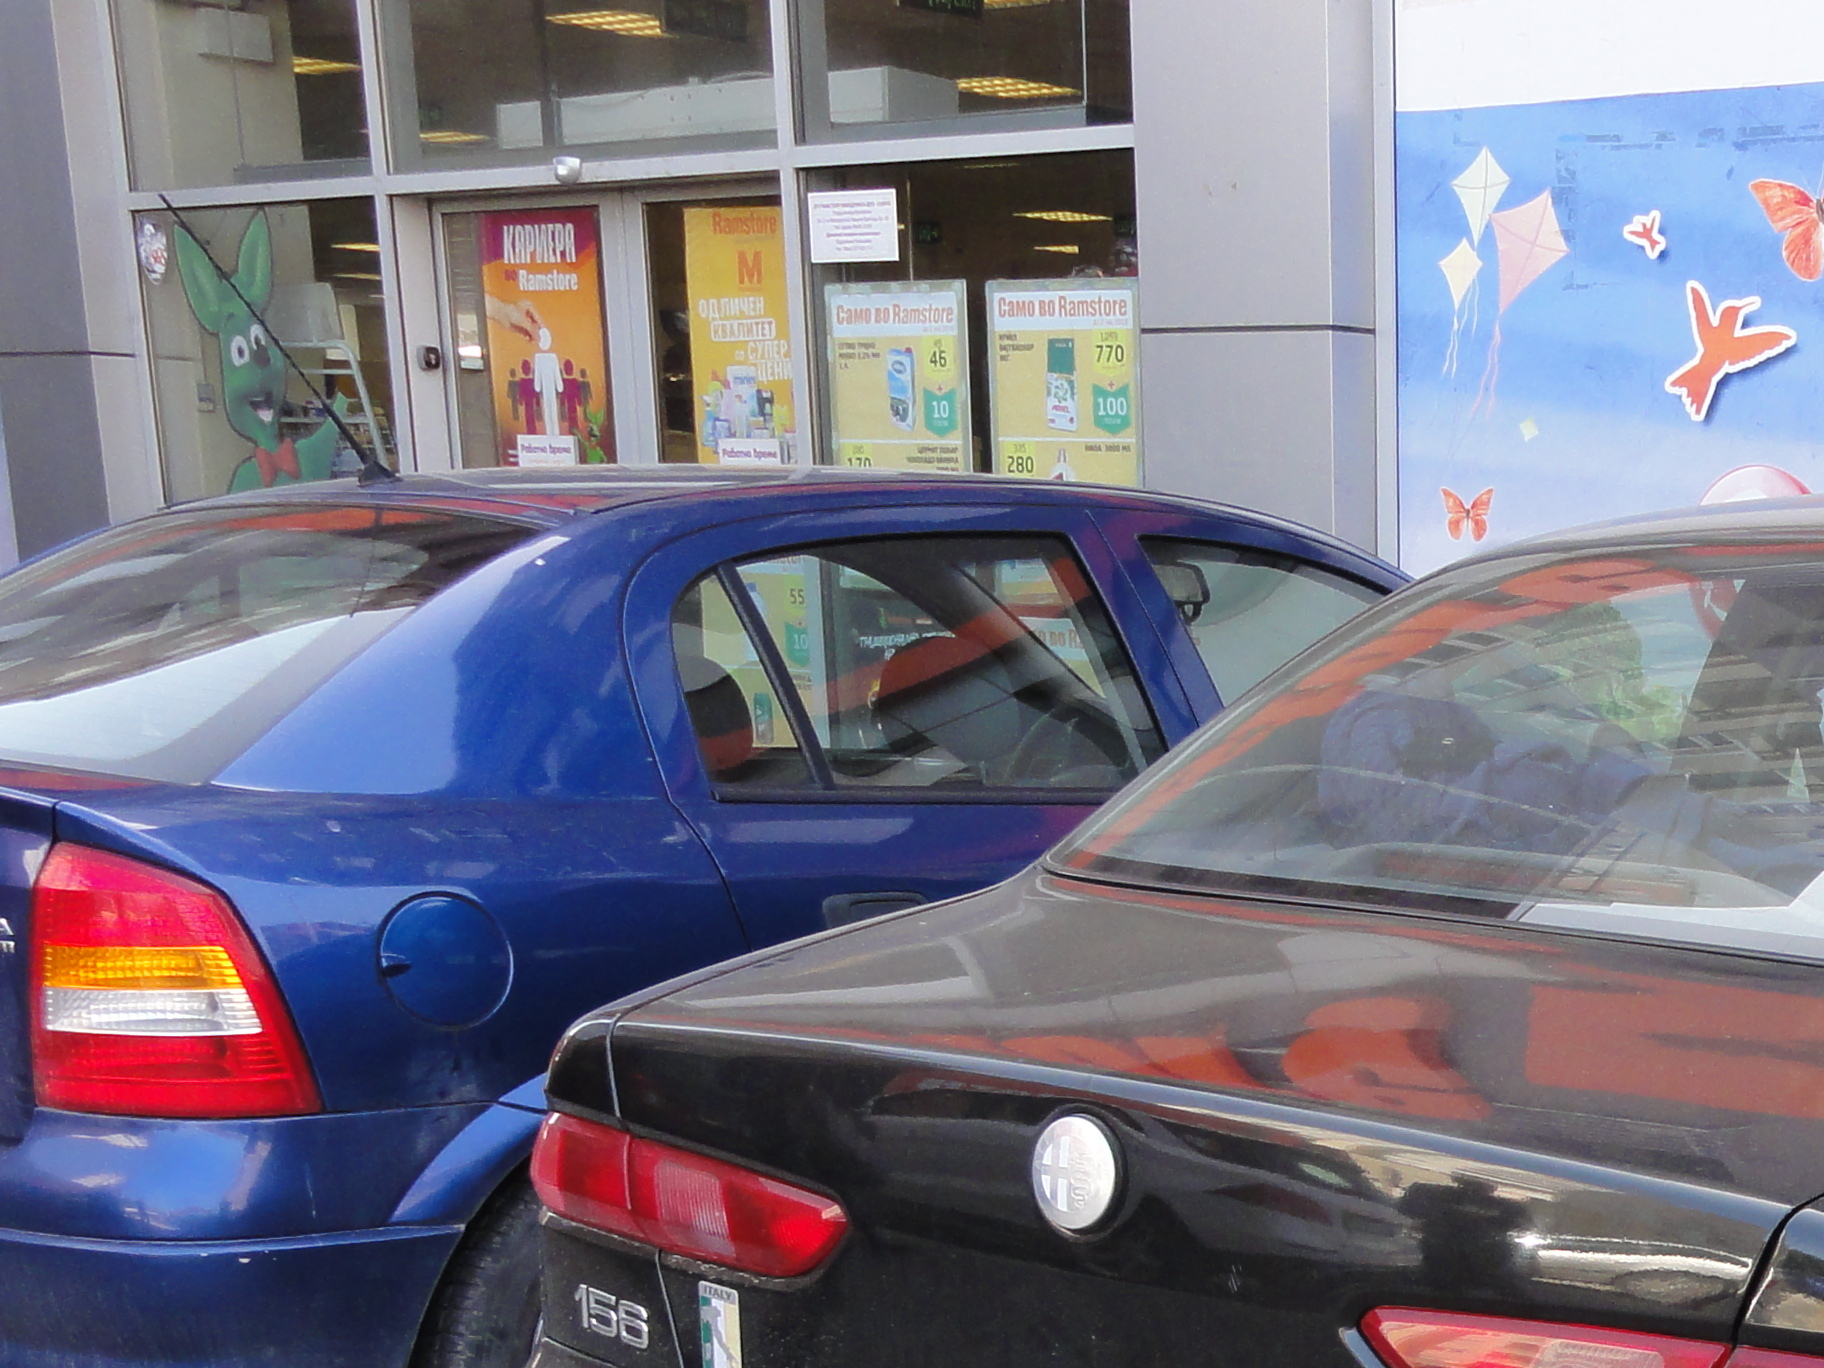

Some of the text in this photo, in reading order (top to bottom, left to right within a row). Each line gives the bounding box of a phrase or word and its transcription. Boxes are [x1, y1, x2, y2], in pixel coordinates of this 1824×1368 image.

[711, 210, 777, 235] Ramstore
[503, 223, 576, 264] КАРИЕРА
[518, 269, 578, 291] Ramstore
[698, 296, 765, 320] ОДЛИЧЕН
[836, 303, 954, 326] Само во Ramstore
[998, 295, 1127, 318] Само во Ramstore
[713, 320, 774, 339] КВАЛИТЕТ
[747, 340, 788, 361] СУПЕР
[929, 350, 947, 367] 46
[1095, 344, 1124, 363] 770
[756, 361, 793, 384] ЦЕНИ
[932, 400, 949, 418] 10
[1097, 398, 1127, 415] 100
[1007, 456, 1034, 473] 280
[789, 588, 804, 605] 55
[704, 1285, 732, 1301] ITALY
[575, 1283, 649, 1350] 156
